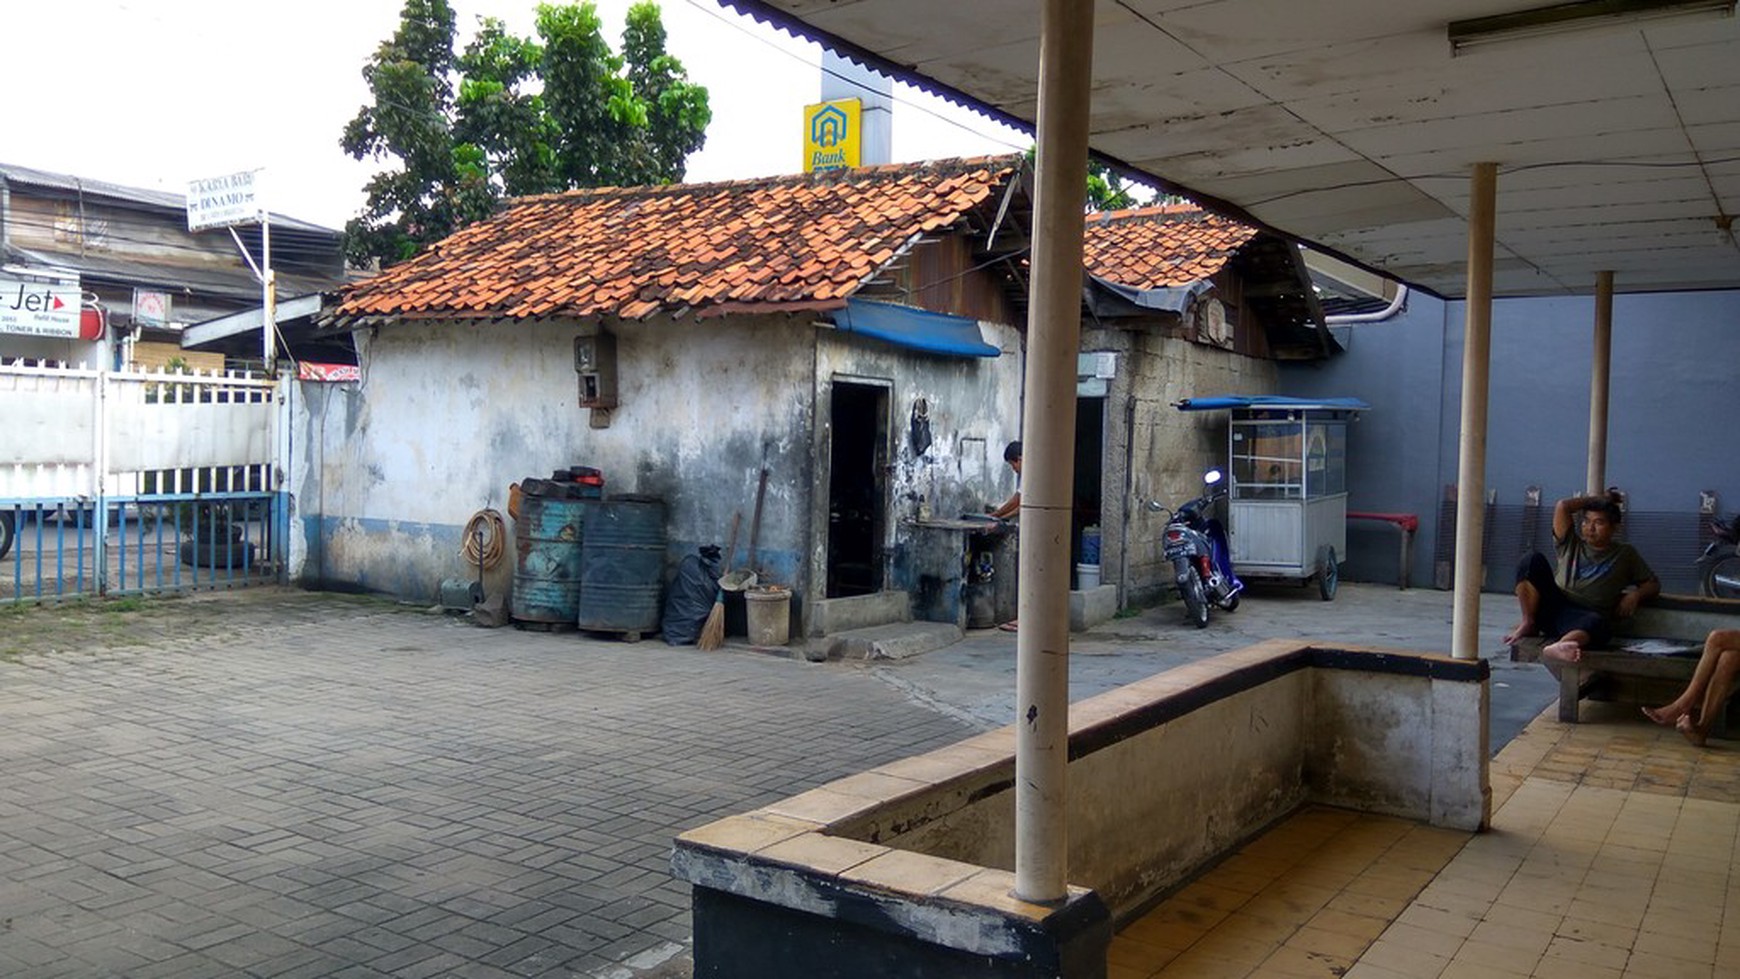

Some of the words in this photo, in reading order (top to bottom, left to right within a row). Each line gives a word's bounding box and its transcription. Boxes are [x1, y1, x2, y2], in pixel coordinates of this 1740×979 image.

[812, 148, 846, 165] Bank
[201, 192, 243, 210] DINAMO
[10, 284, 53, 312] Jet
[6, 324, 33, 332] TONER
[43, 328, 72, 336] RIBBON
